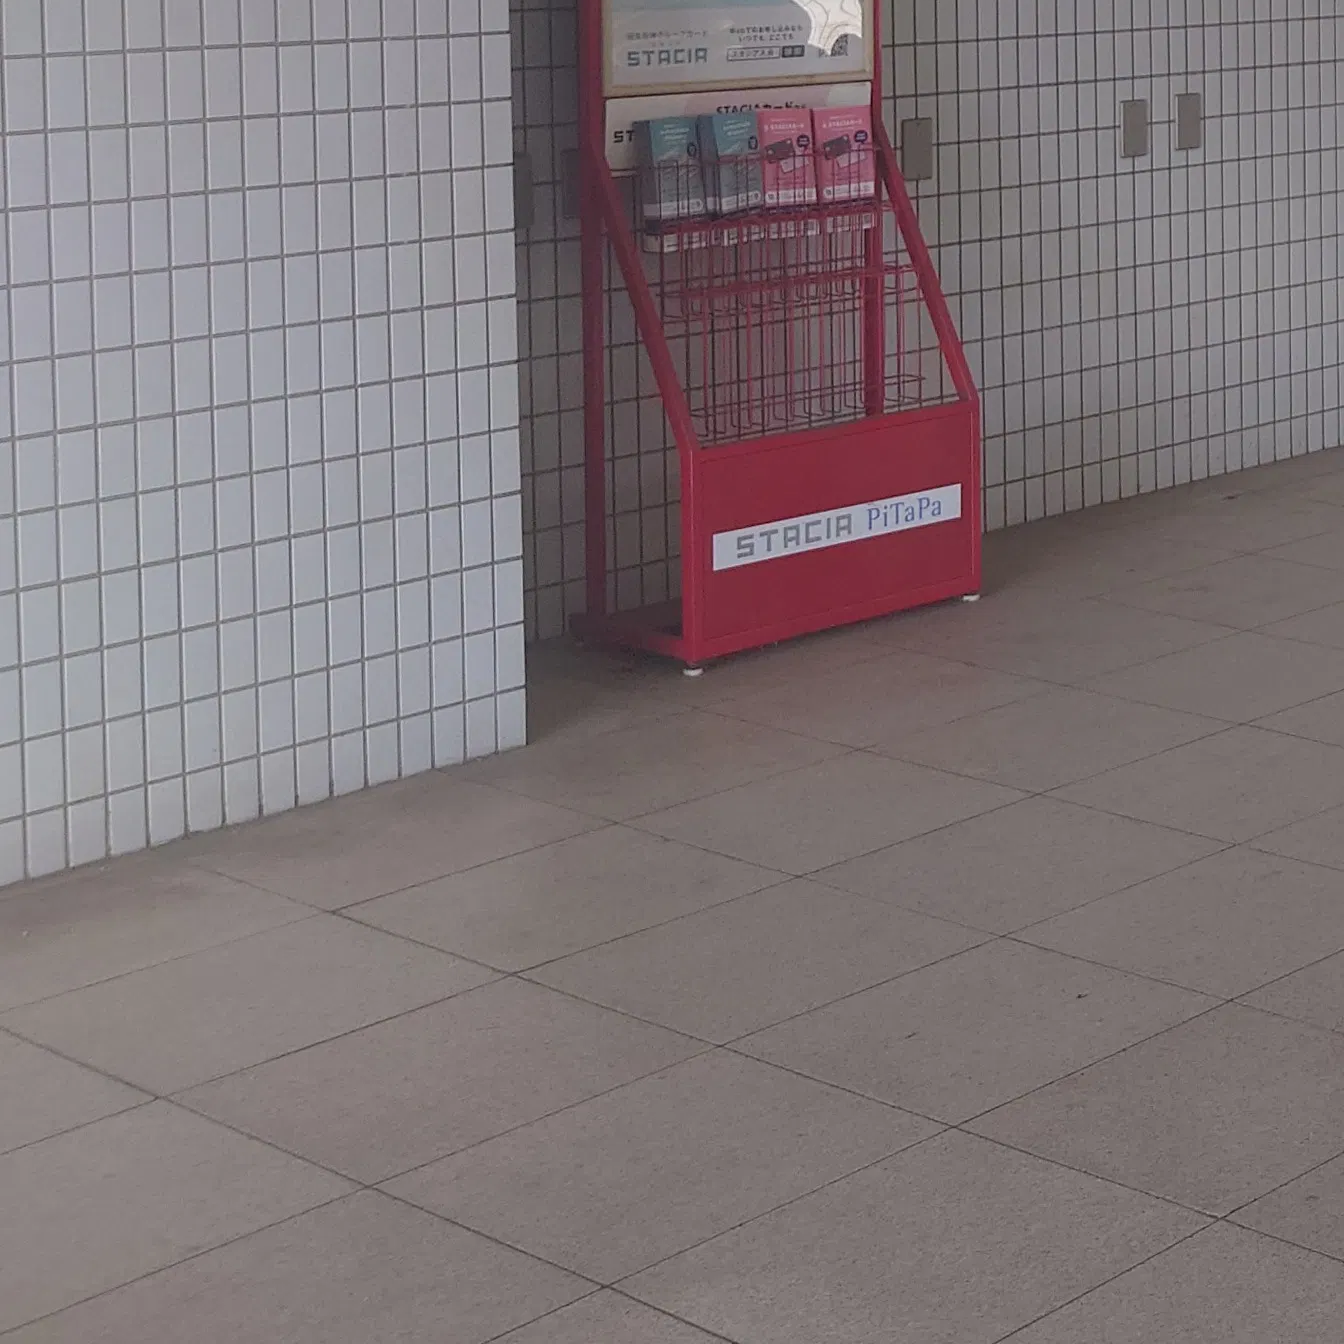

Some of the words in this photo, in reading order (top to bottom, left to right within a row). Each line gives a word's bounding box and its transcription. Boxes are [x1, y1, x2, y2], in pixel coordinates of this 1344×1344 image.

[627, 47, 708, 67] STACIA
[736, 513, 852, 559] STACIA
[867, 496, 942, 530] PiTaPa
